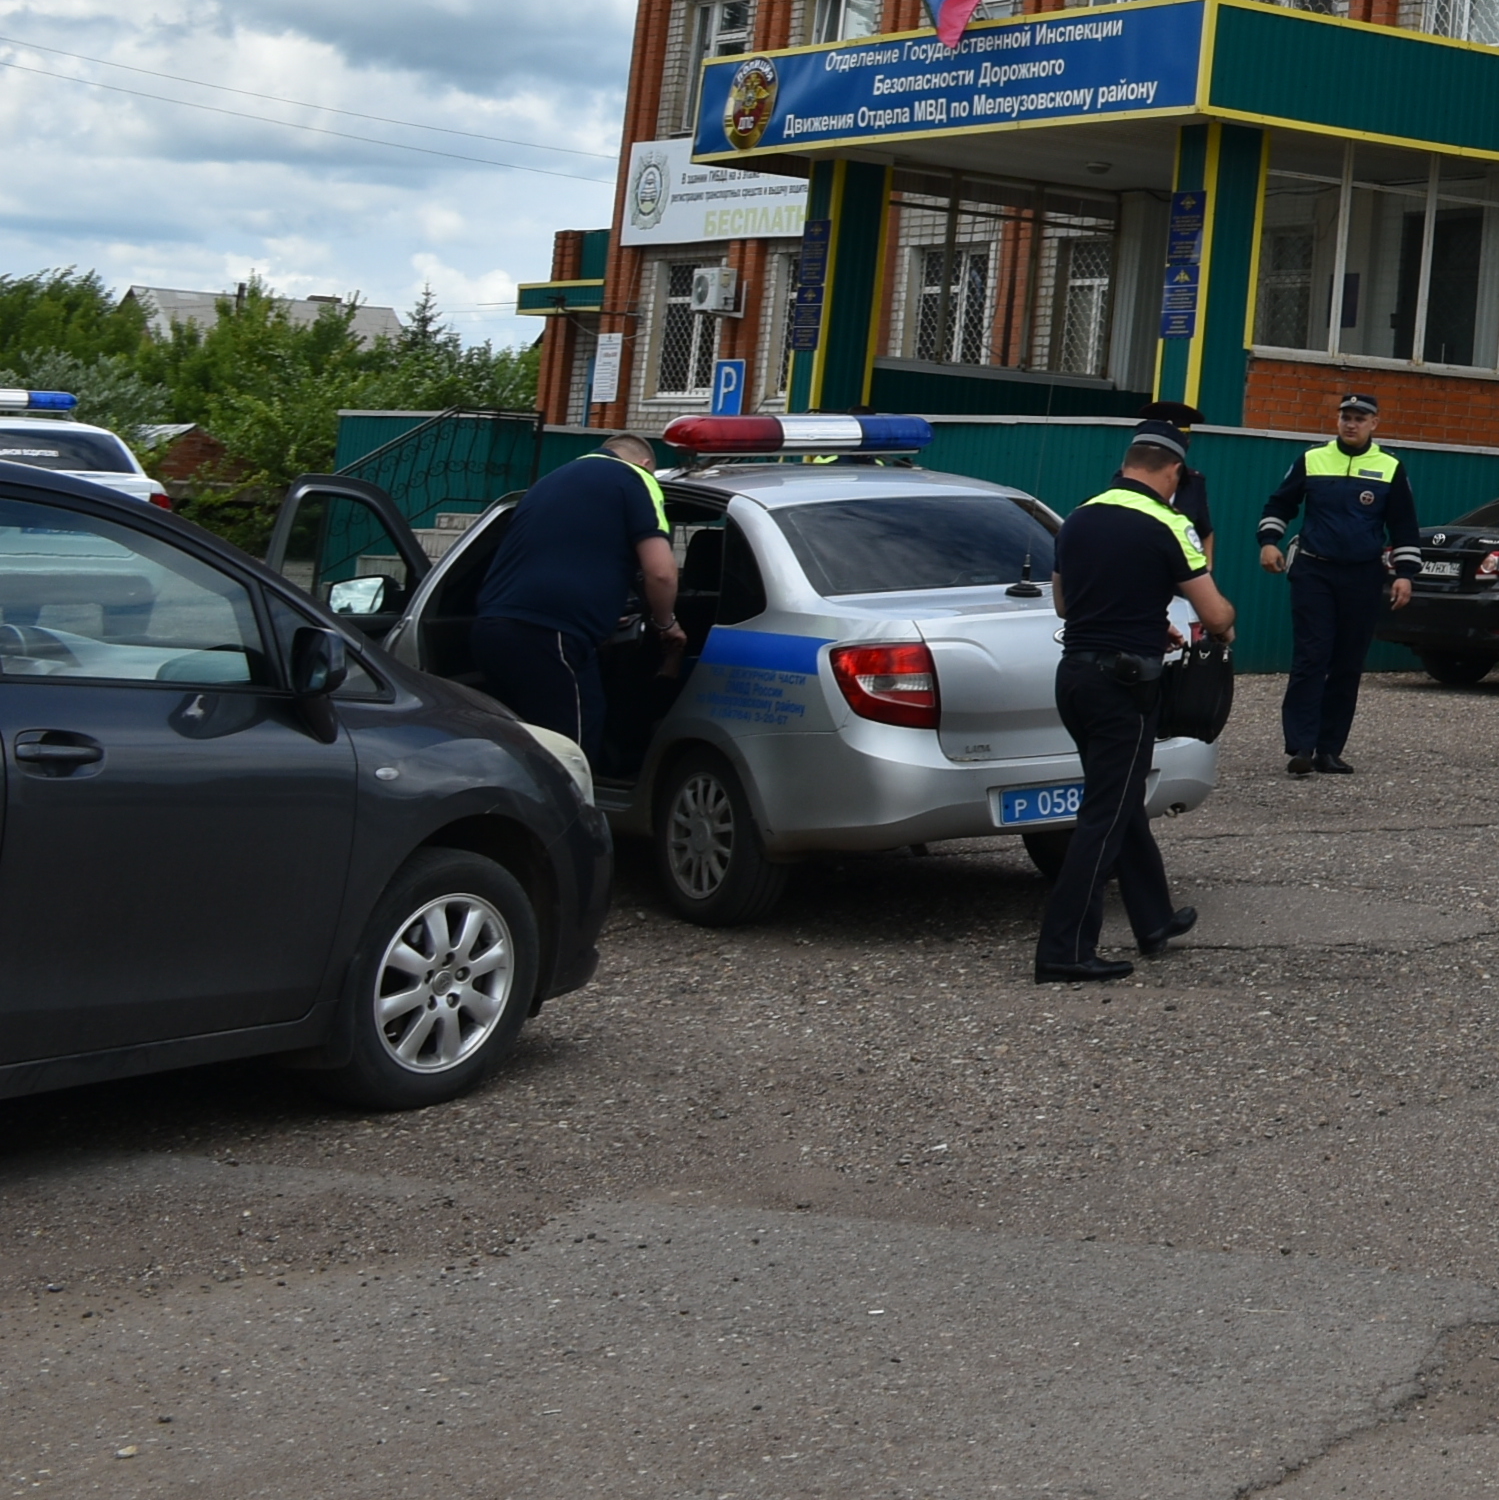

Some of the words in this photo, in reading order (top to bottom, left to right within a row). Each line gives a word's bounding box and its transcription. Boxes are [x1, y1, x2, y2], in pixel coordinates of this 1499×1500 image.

[825, 48, 899, 73] Отделение
[903, 25, 1031, 65] Государственной
[1035, 19, 1123, 46] Инспекции
[737, 59, 774, 82] ПОЛИЦИЯ
[873, 69, 974, 96] Безопасности
[978, 58, 1065, 88] Дорожного
[783, 113, 854, 138] Движения
[857, 106, 910, 129] Отдела
[914, 98, 947, 124] МВД
[950, 101, 969, 119] по
[973, 88, 1094, 117] Мелеузовскому
[1097, 78, 1158, 108] району
[738, 116, 754, 130] ДПС
[709, 169, 728, 183] ГИБДД
[717, 366, 736, 412] P
[752, 682, 783, 698] России
[778, 674, 807, 686] ЧАСТИ
[774, 700, 806, 717] району
[1037, 788, 1084, 815] 058
